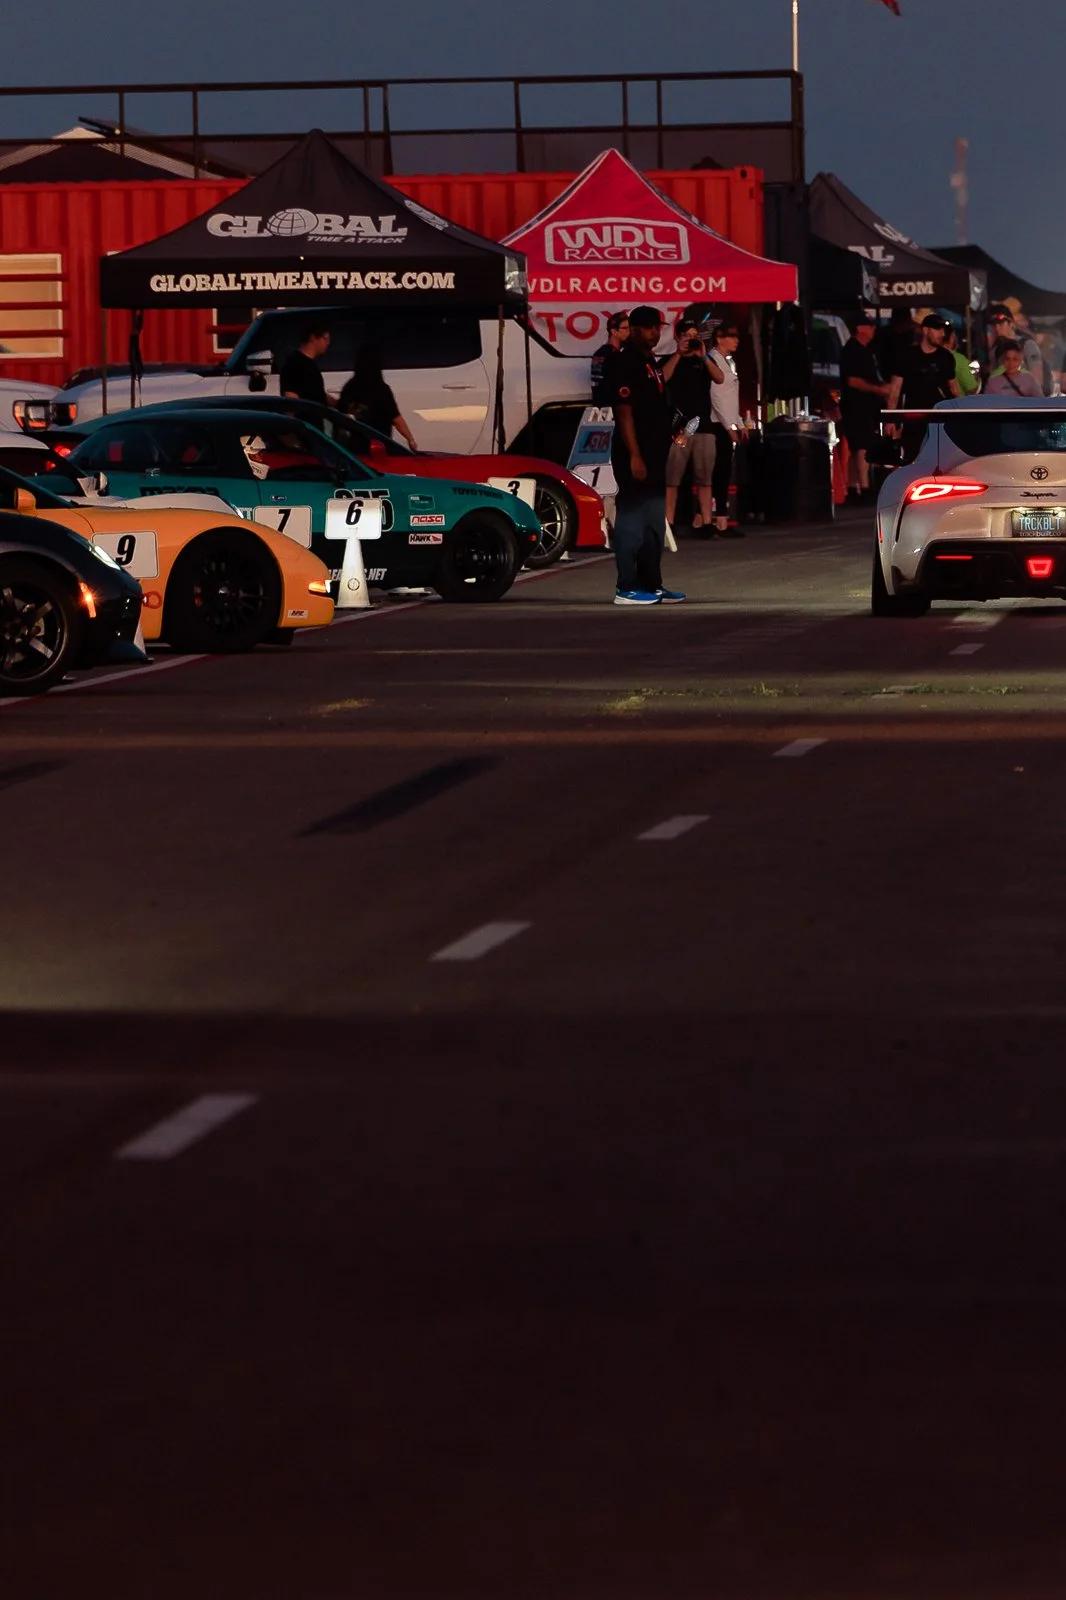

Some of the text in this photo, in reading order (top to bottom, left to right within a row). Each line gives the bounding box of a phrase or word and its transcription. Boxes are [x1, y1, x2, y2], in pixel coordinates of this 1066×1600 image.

[206, 208, 408, 238] GLOBAL
[346, 236, 407, 244] ATTACK
[557, 225, 677, 249] WDL
[564, 248, 679, 261] RACING
[150, 272, 455, 292] GLOBALTIMEATTACK.COM
[592, 467, 600, 487] 1
[278, 509, 291, 532] 7
[345, 500, 364, 526] 6
[411, 515, 443, 523] nasa
[1019, 517, 1061, 531] TRCKBLT
[410, 534, 431, 542] HAWK
[116, 535, 136, 565] 9
